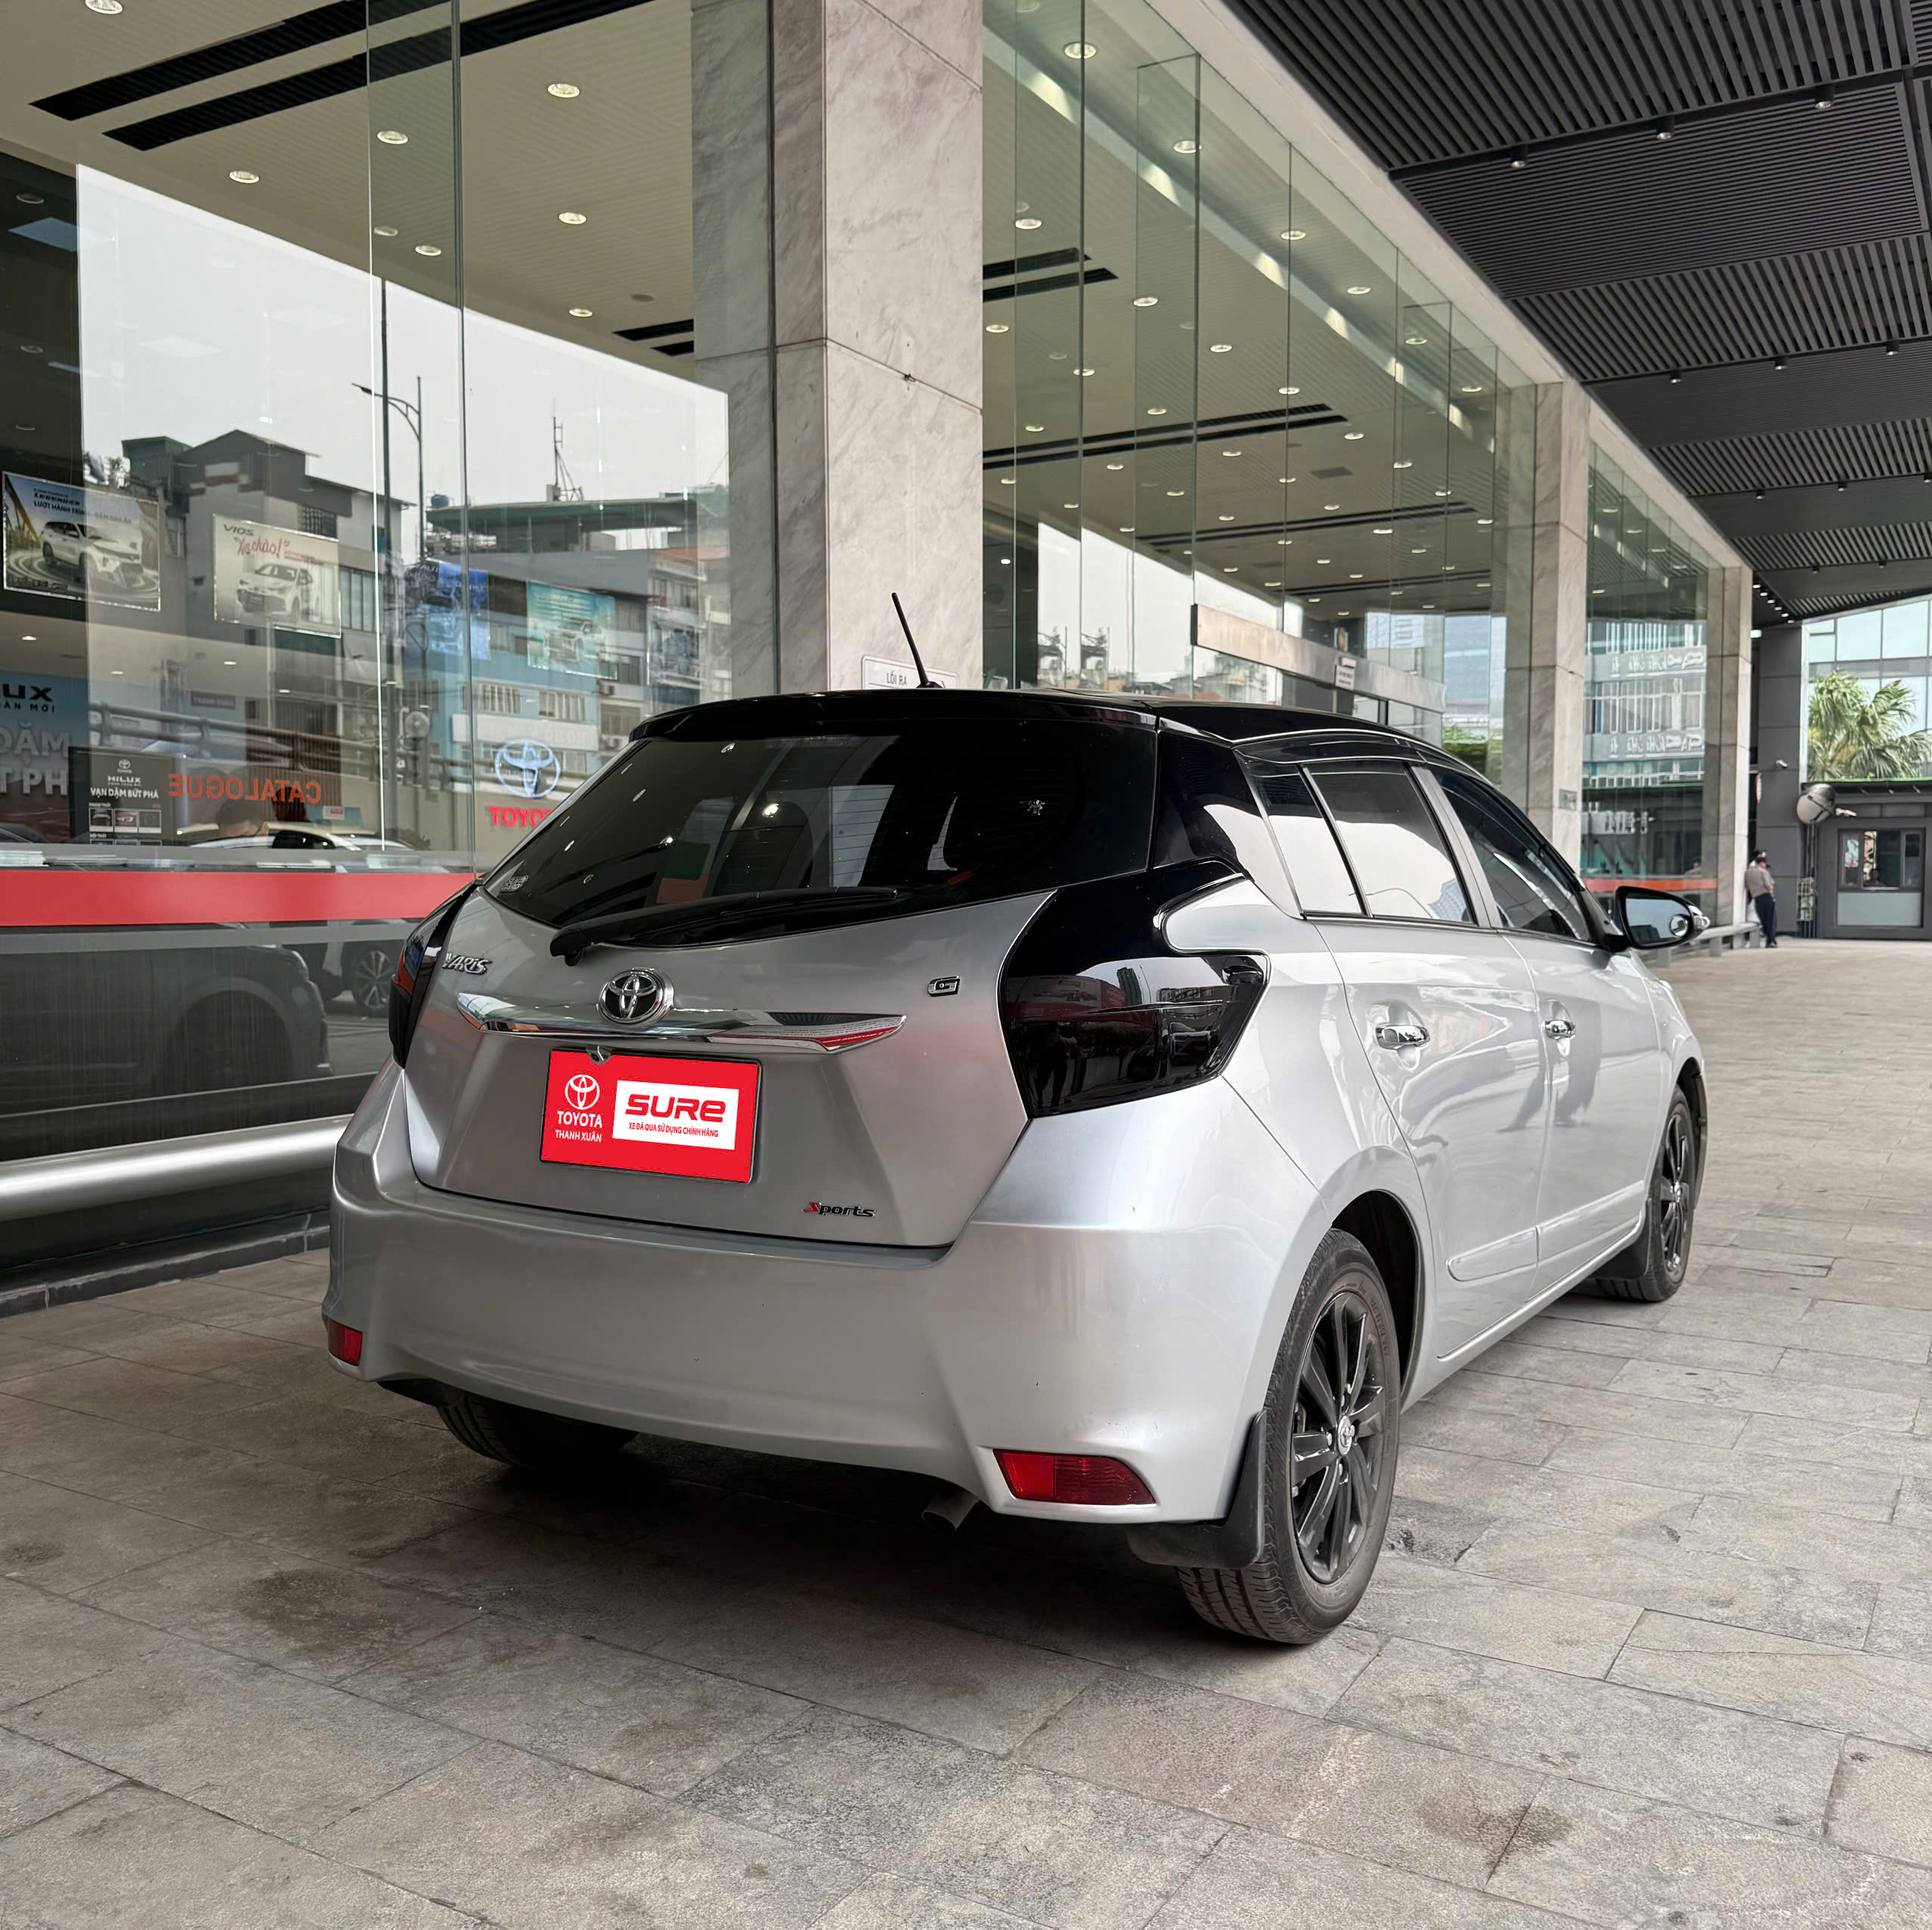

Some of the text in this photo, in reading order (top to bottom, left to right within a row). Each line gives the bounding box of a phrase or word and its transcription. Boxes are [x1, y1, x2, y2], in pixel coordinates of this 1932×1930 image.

[887, 670, 907, 687] LỐI RA
[107, 775, 141, 784] HILUX
[90, 787, 107, 799] VẠN
[143, 789, 159, 799] PHÁ
[801, 1202, 877, 1217] Sports
